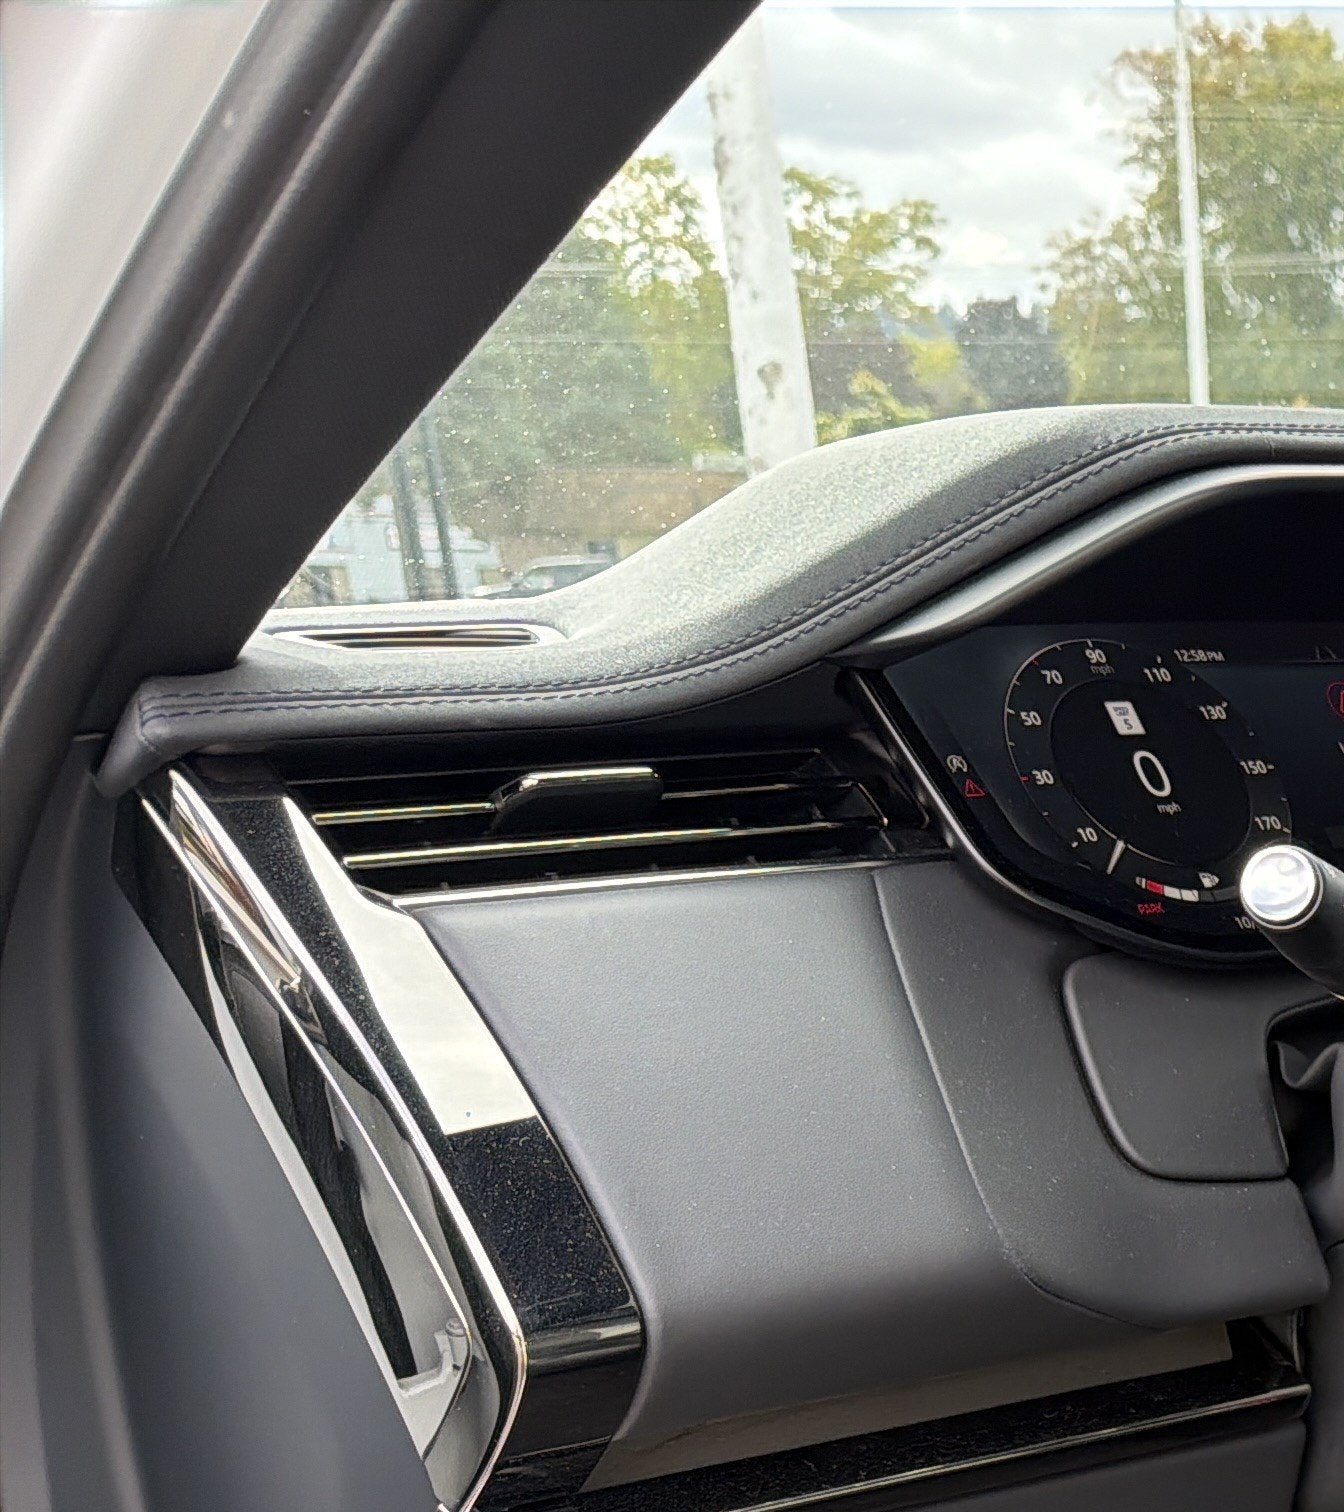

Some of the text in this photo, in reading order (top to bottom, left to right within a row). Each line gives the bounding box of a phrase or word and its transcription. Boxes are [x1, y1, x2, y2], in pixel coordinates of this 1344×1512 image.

[1085, 649, 1107, 664] 90
[1041, 669, 1063, 685] 70
[1090, 665, 1115, 676] mph
[1143, 667, 1172, 683] 110
[1020, 711, 1042, 727] 50
[1199, 705, 1228, 721] 130
[1123, 718, 1133, 730] 5
[1133, 750, 1172, 798] 0
[1239, 760, 1267, 776] 150
[1032, 769, 1054, 785] 30
[1157, 801, 1182, 816] mph
[1254, 815, 1282, 831] 170
[1077, 826, 1098, 843] 10
